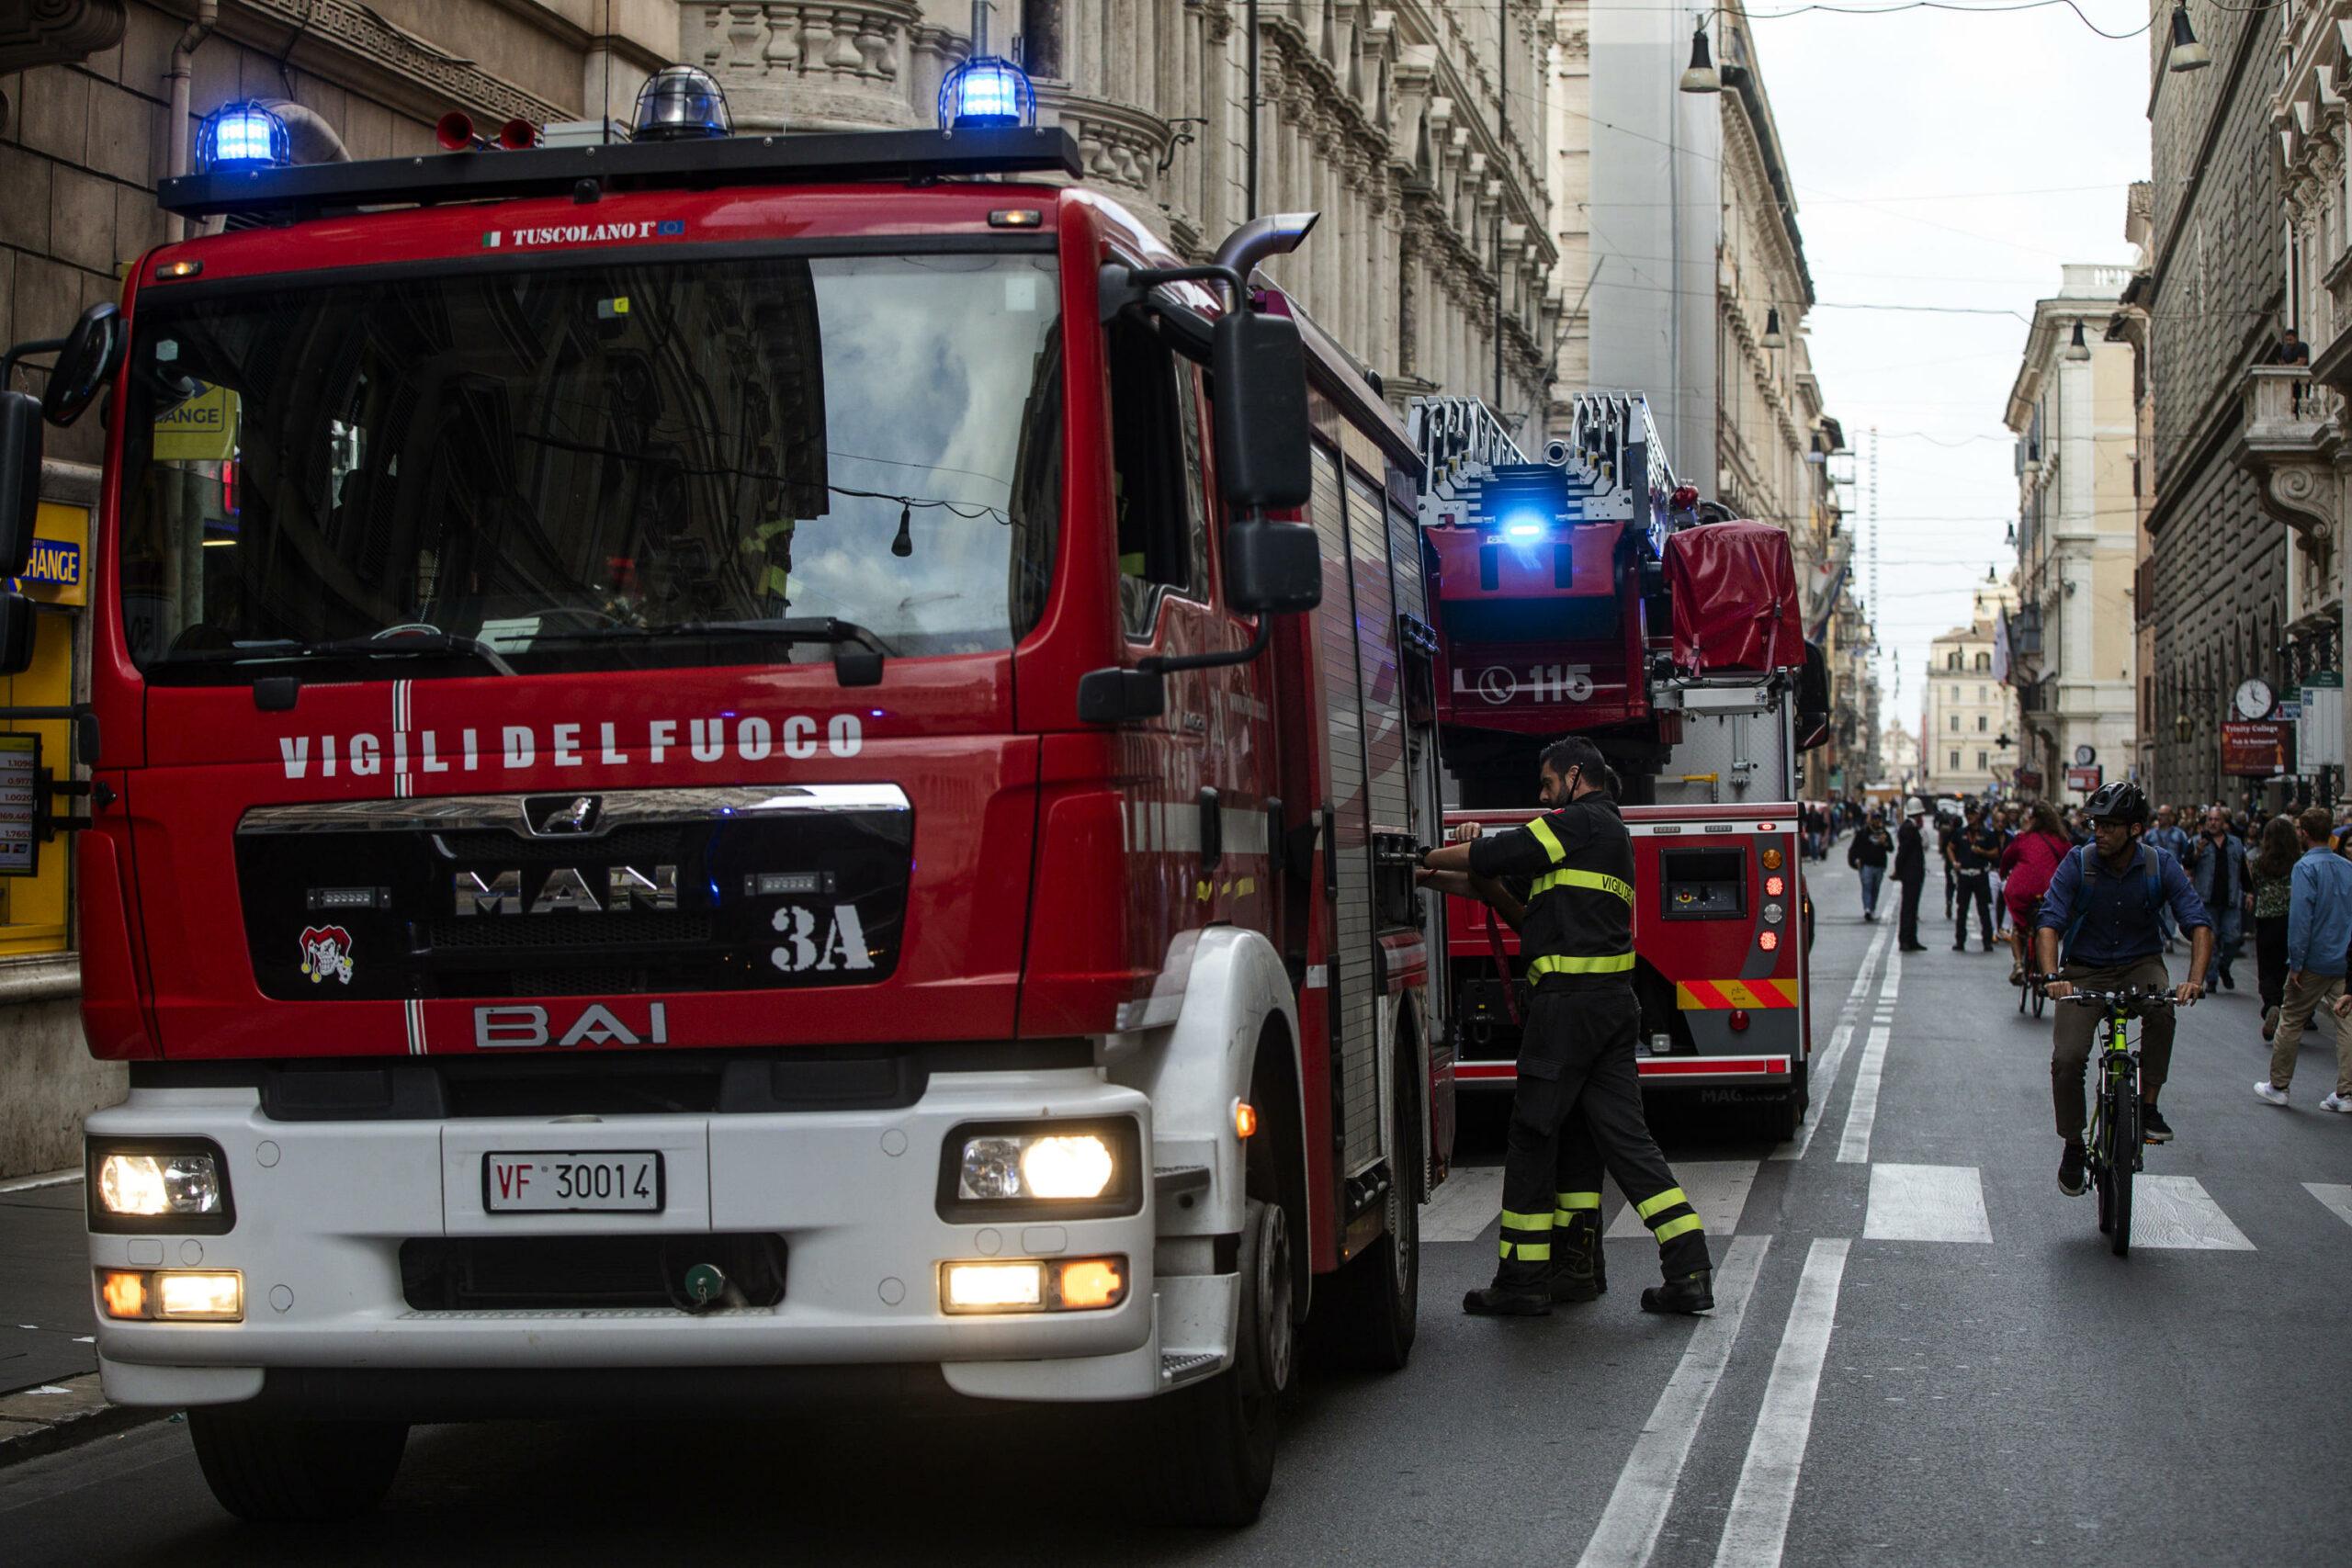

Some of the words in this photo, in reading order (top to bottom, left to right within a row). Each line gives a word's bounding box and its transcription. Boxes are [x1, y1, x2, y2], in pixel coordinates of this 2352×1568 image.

[513, 222, 636, 246] TUSCOLANO
[1529, 663, 1593, 703] 115
[279, 728, 478, 779] VIGILI
[502, 722, 628, 769] DEL
[650, 714, 863, 763] FUOCO
[2225, 725, 2250, 734] Trinity
[2252, 724, 2278, 734] College
[456, 865, 678, 915] MAN
[771, 905, 876, 972] 3A
[474, 1002, 667, 1048] BAI
[497, 1164, 533, 1199] VF
[555, 1164, 650, 1199] 30014
